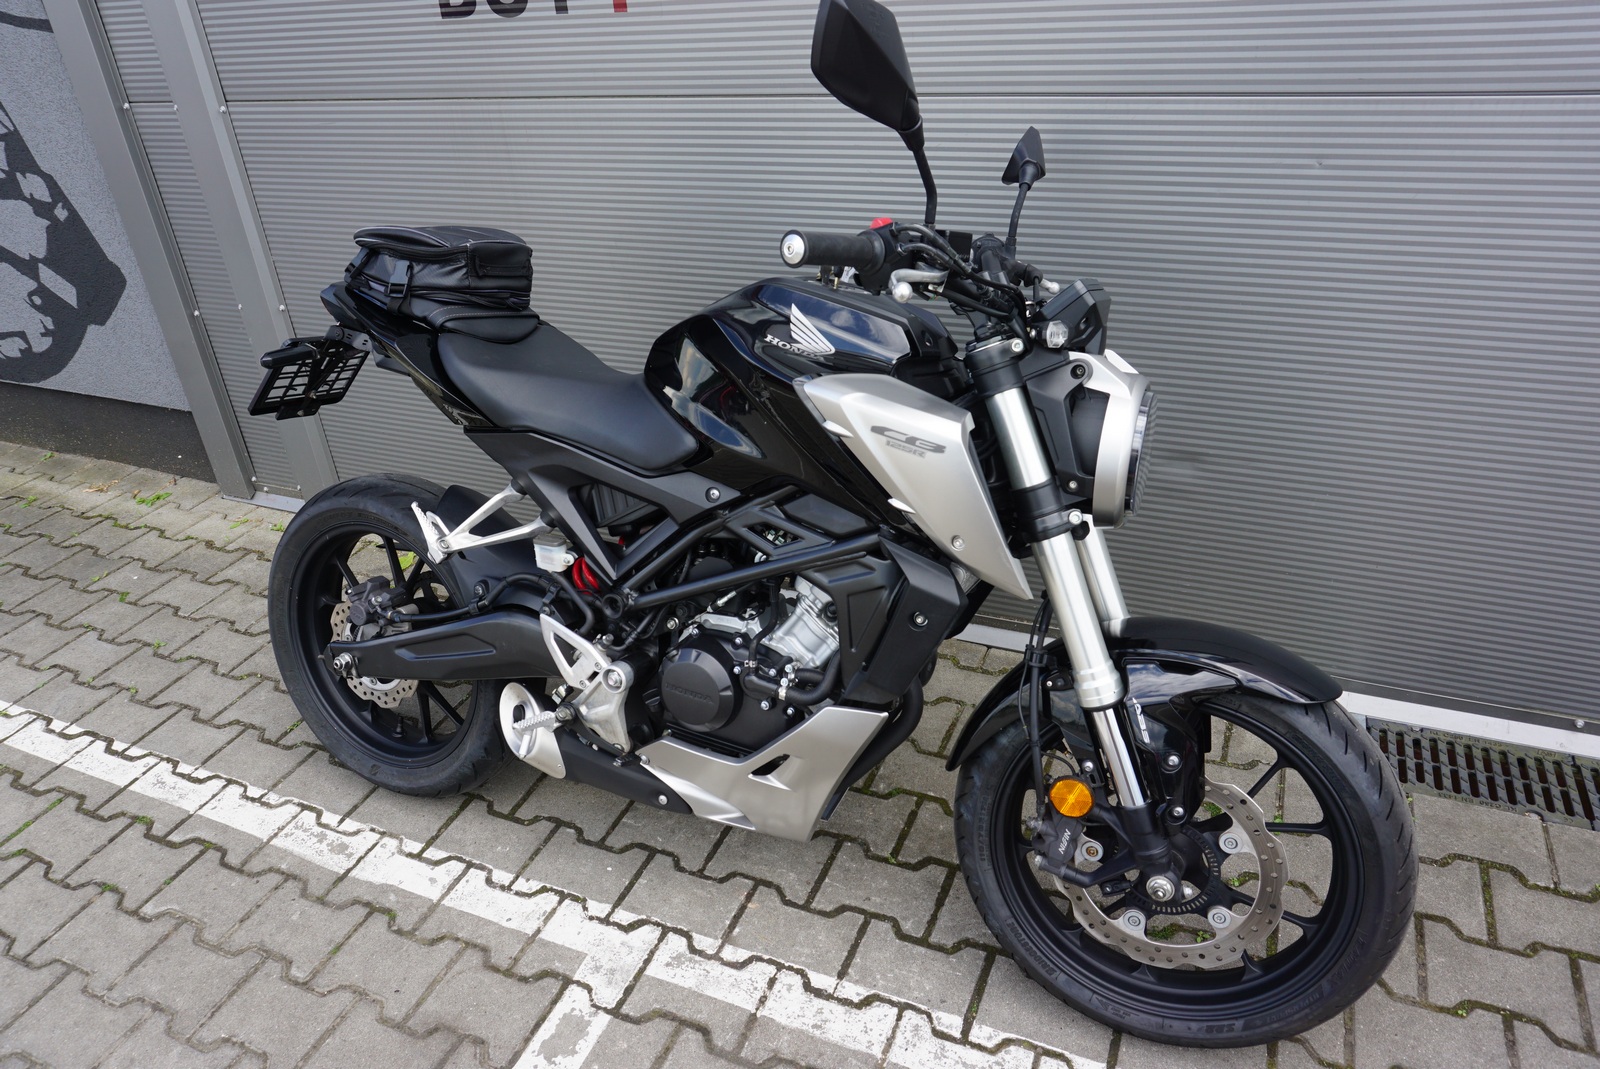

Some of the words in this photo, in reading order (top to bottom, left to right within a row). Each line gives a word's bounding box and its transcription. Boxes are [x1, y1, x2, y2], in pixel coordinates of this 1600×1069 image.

[870, 425, 947, 454] CB
[885, 439, 927, 459] 125R
[664, 682, 715, 706] HONDA
[1132, 697, 1150, 744] ABS
[1006, 921, 1058, 977] BRIDGESTONE
